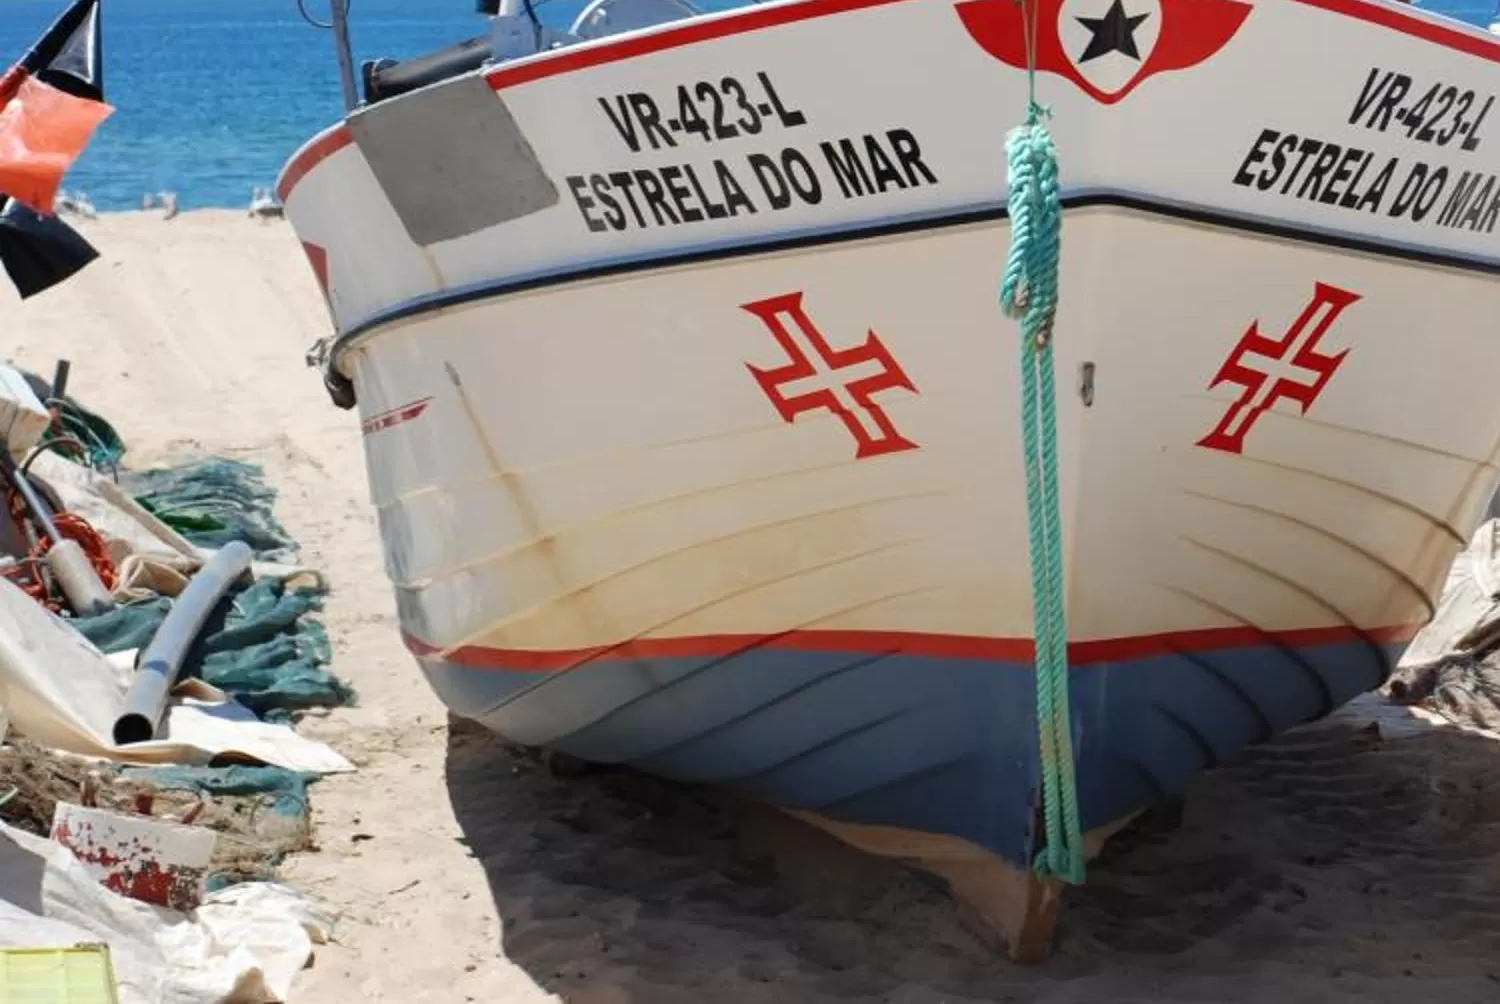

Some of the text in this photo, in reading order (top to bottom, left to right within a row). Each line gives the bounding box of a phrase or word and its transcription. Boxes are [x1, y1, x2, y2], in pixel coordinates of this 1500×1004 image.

[597, 71, 807, 153] VR-423-L
[1347, 67, 1496, 152] VR-423-L
[565, 128, 939, 233] ESTRELA DO MAR
[1232, 128, 1400, 214] ESTRELA
[1387, 161, 1449, 229] DO
